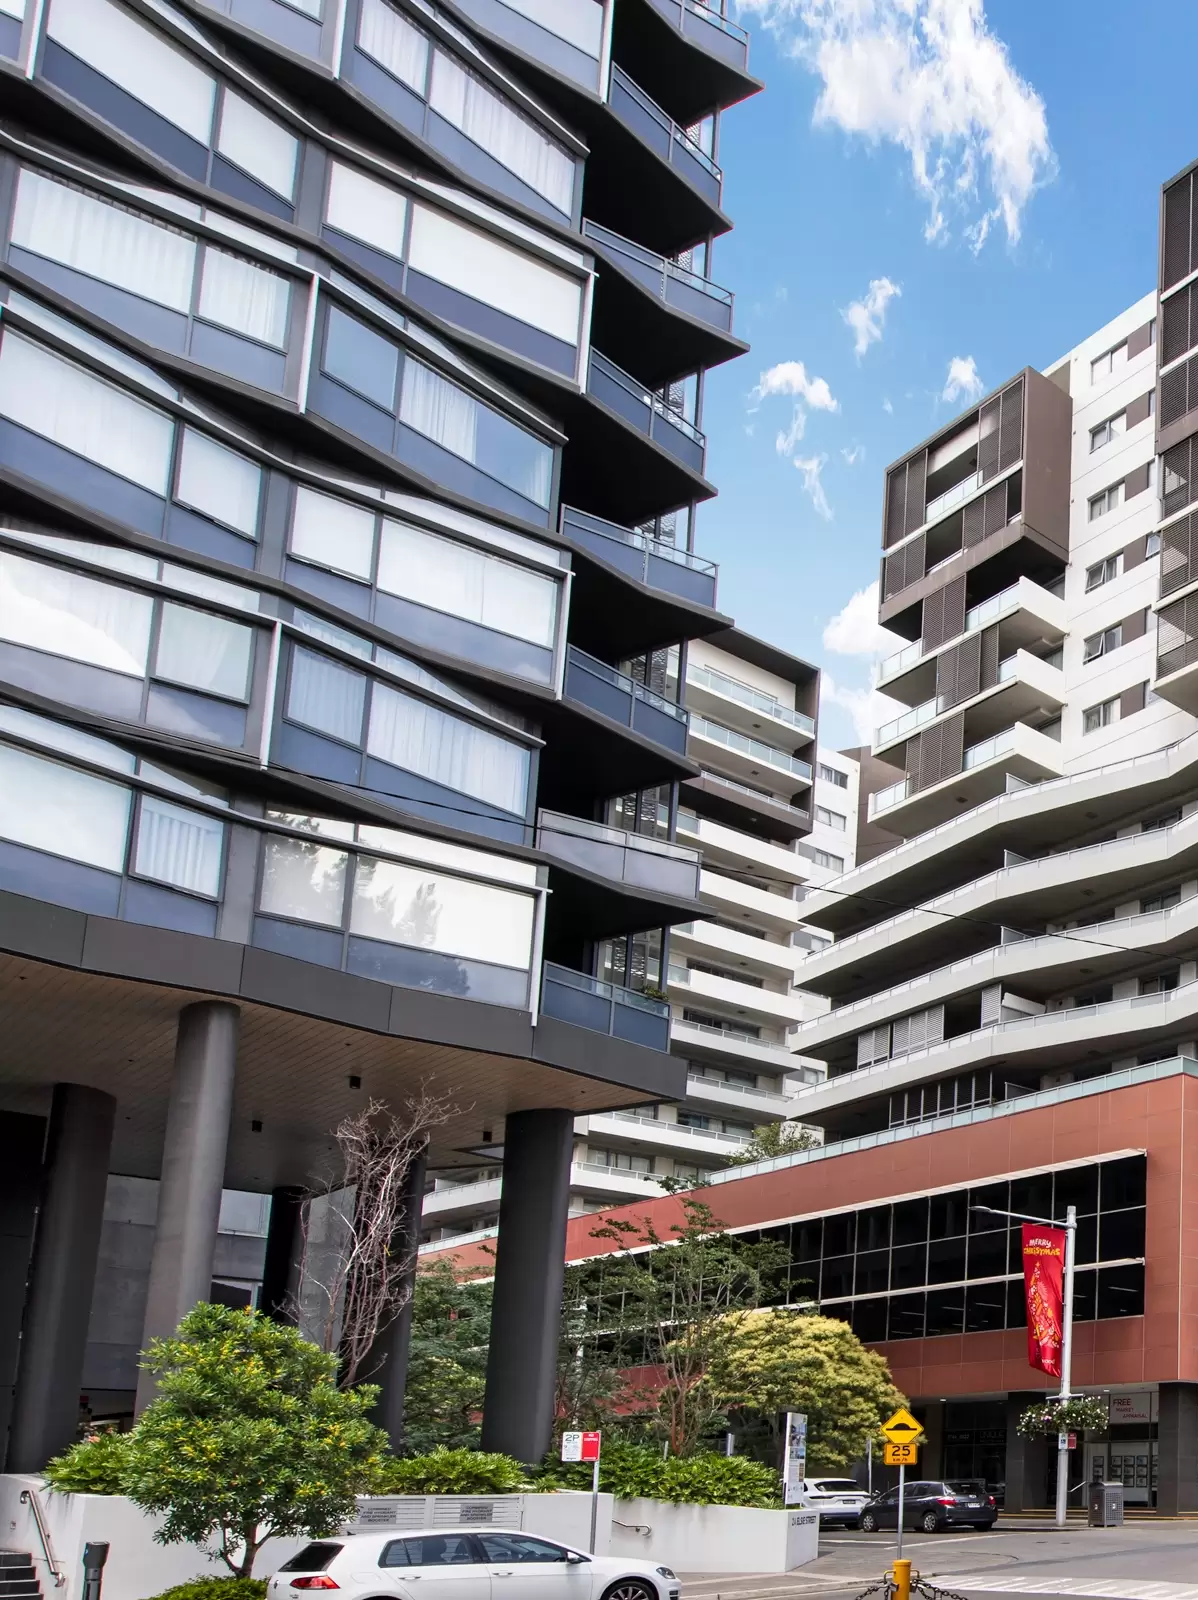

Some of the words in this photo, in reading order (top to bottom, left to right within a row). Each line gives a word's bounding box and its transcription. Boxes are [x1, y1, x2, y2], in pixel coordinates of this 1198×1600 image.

[1028, 1238, 1052, 1249] MERRY
[1023, 1247, 1061, 1256] CHRISTMAS
[1112, 1398, 1132, 1406] FREE
[892, 1445, 911, 1457] 25
[806, 1516, 816, 1524] STREET
